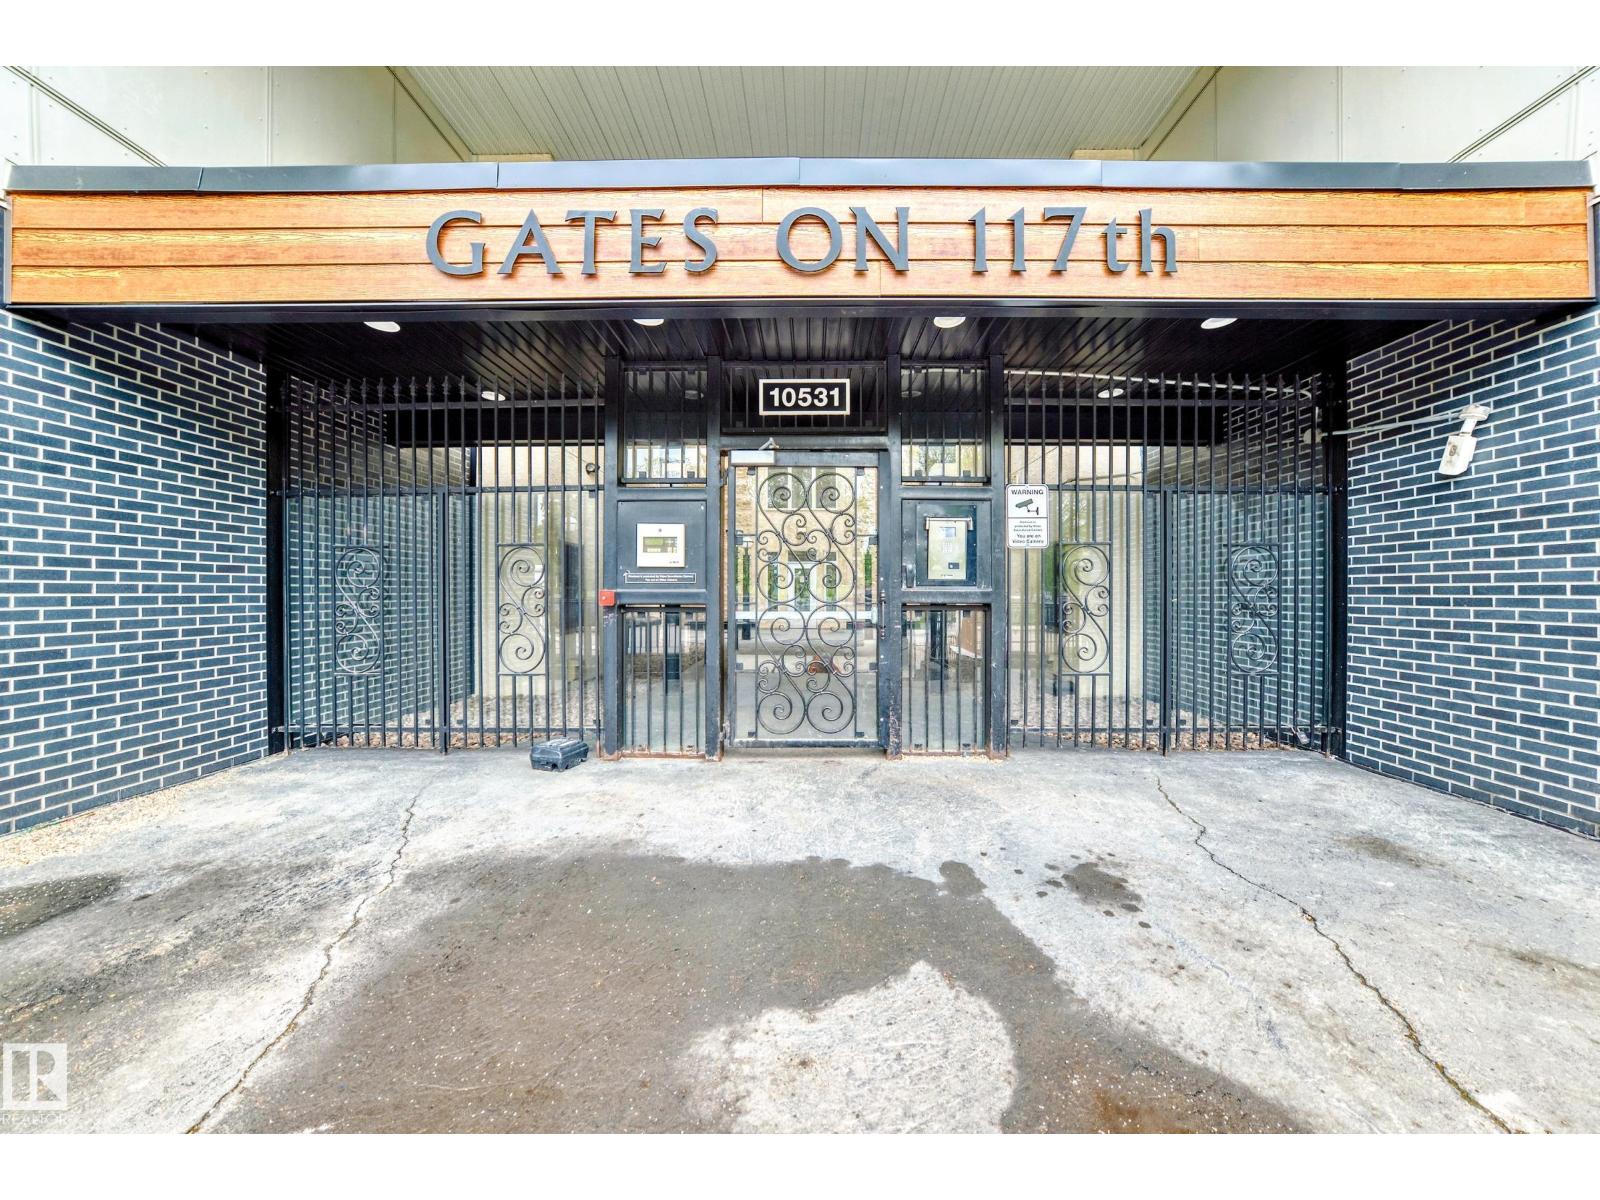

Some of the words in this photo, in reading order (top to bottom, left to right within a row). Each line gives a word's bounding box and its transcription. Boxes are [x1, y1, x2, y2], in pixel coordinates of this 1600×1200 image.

[425, 208, 719, 276] GATES
[776, 206, 910, 274] ON
[967, 206, 1178, 274] 117th
[769, 387, 840, 407] 10531
